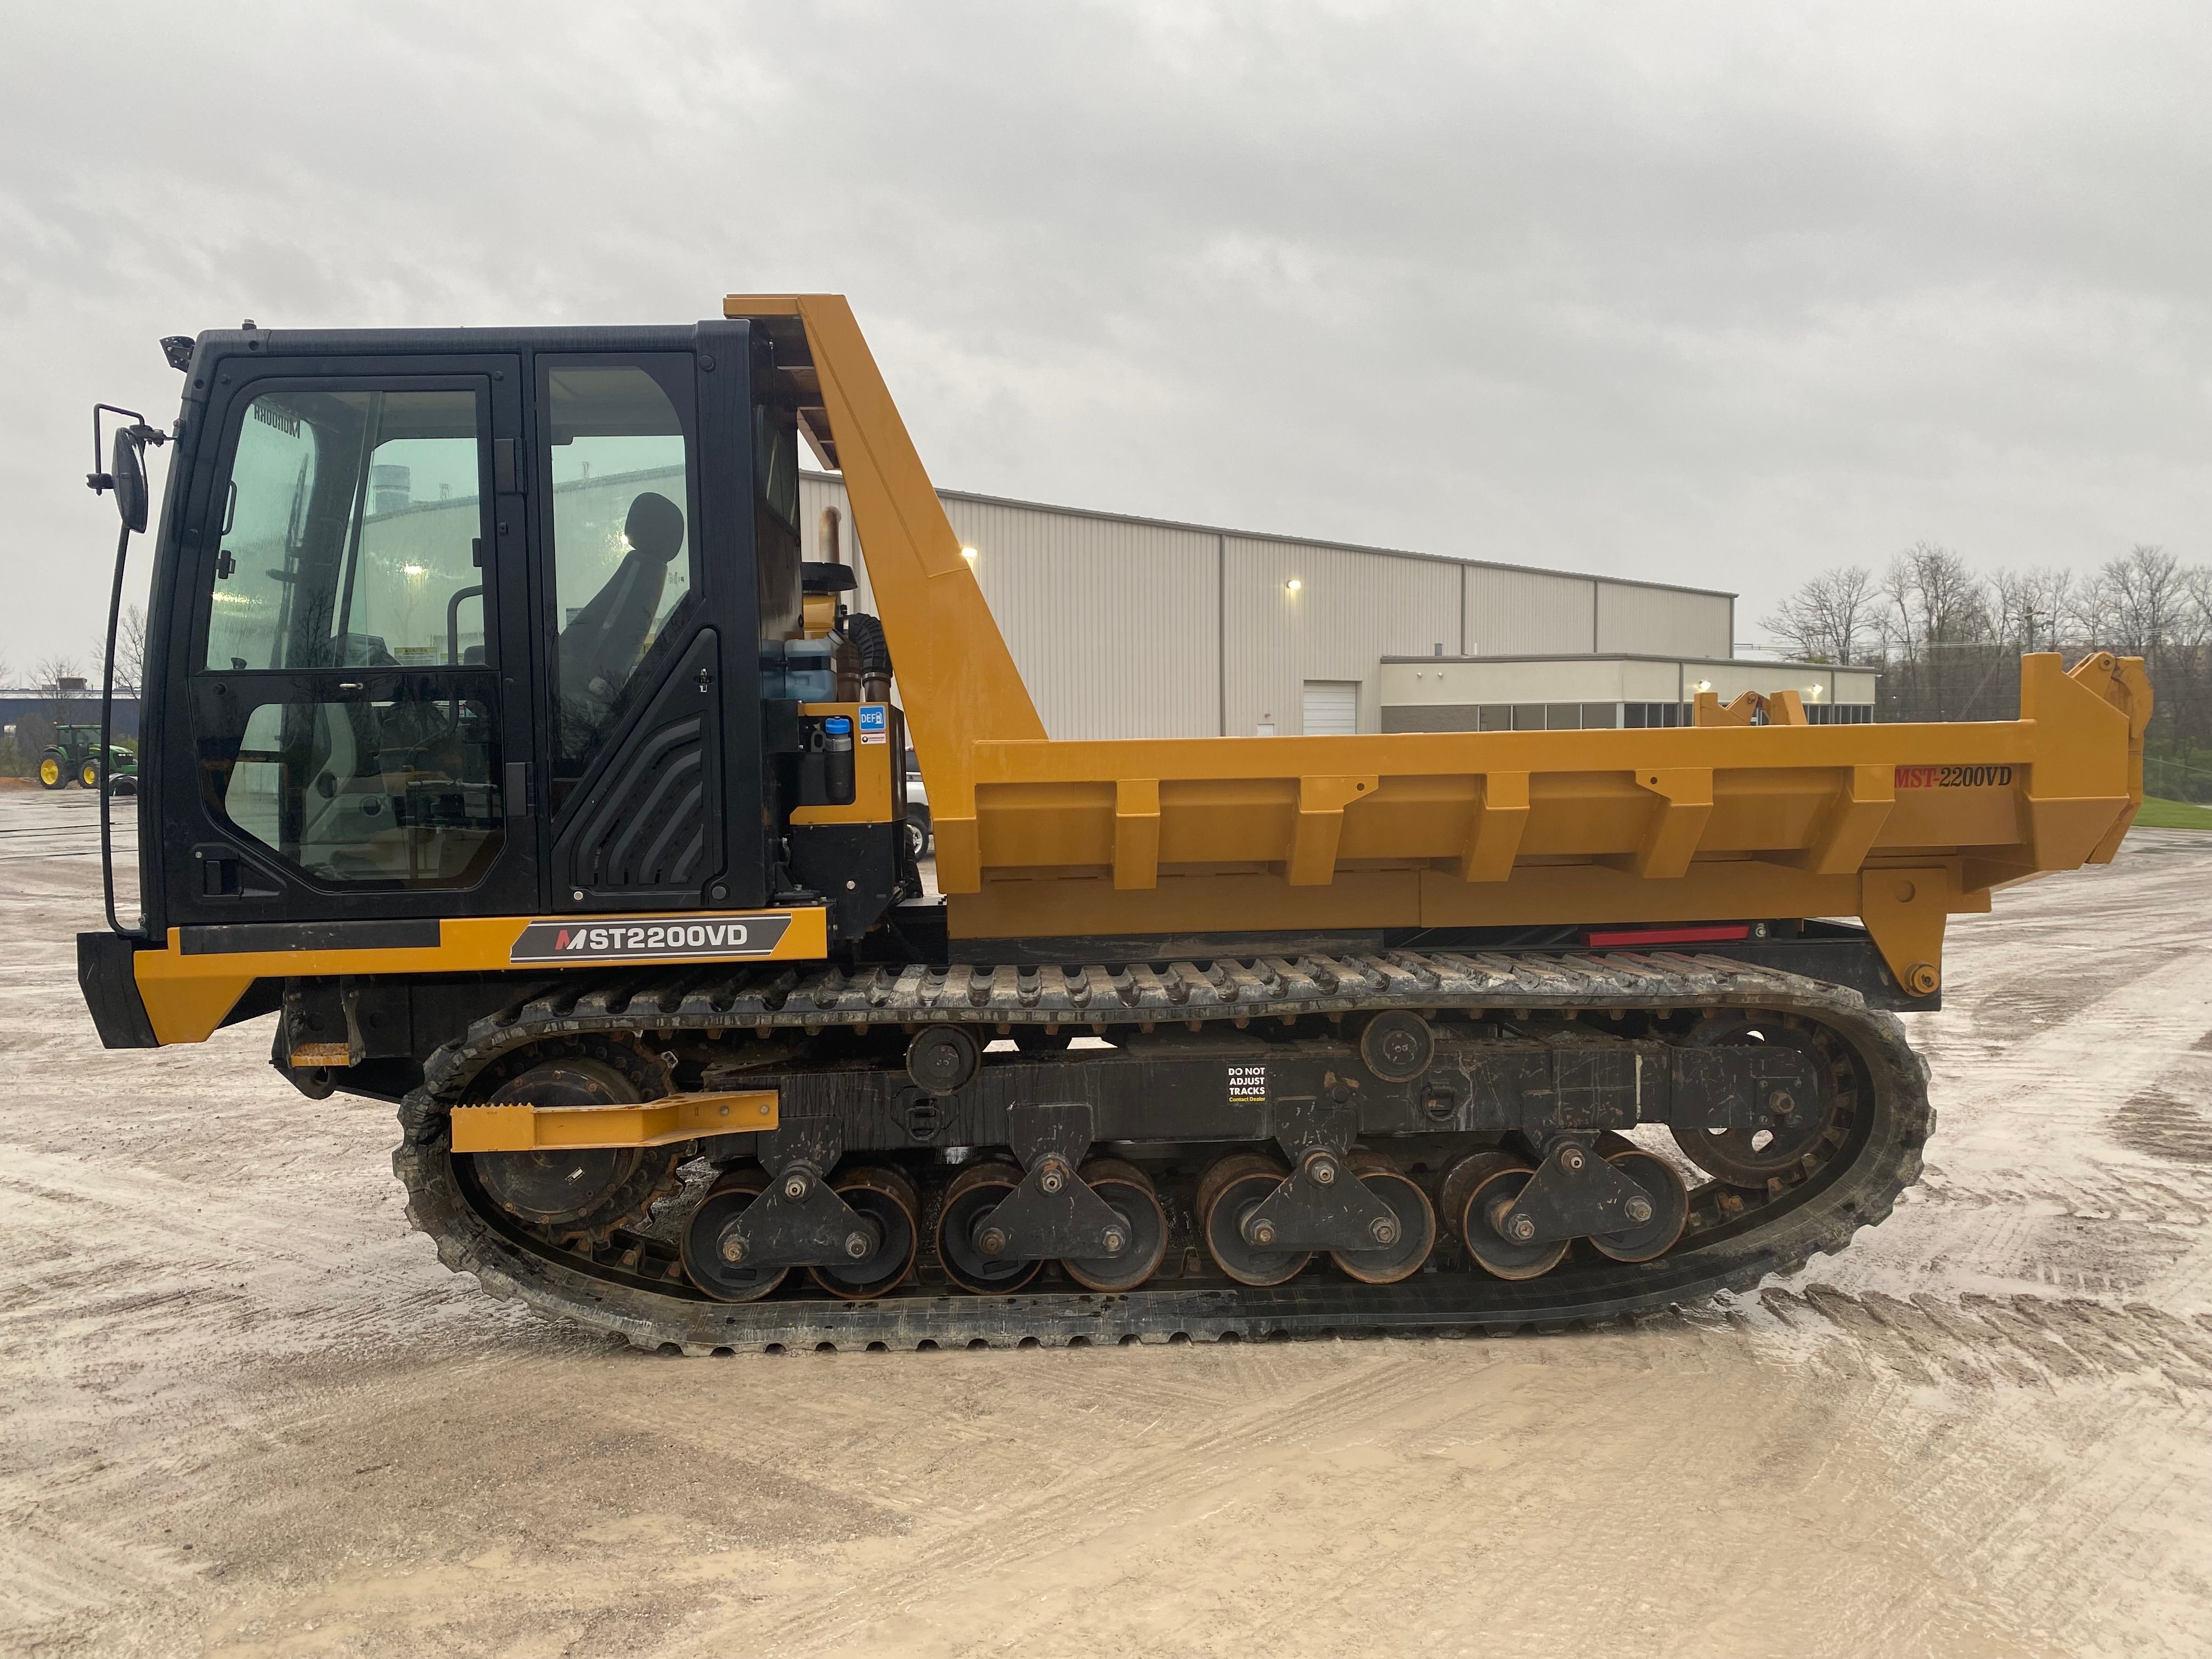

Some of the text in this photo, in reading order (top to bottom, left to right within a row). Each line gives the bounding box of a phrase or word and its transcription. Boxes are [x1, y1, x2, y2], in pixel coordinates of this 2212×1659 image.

[861, 714, 876, 723] DEF
[1894, 766, 2012, 788] MST-2200VD
[555, 924, 748, 950] MST2200VD
[1228, 1067, 1265, 1076] DO NOT
[1229, 1077, 1265, 1085] ADJUST
[1229, 1087, 1265, 1095] TRACKS
